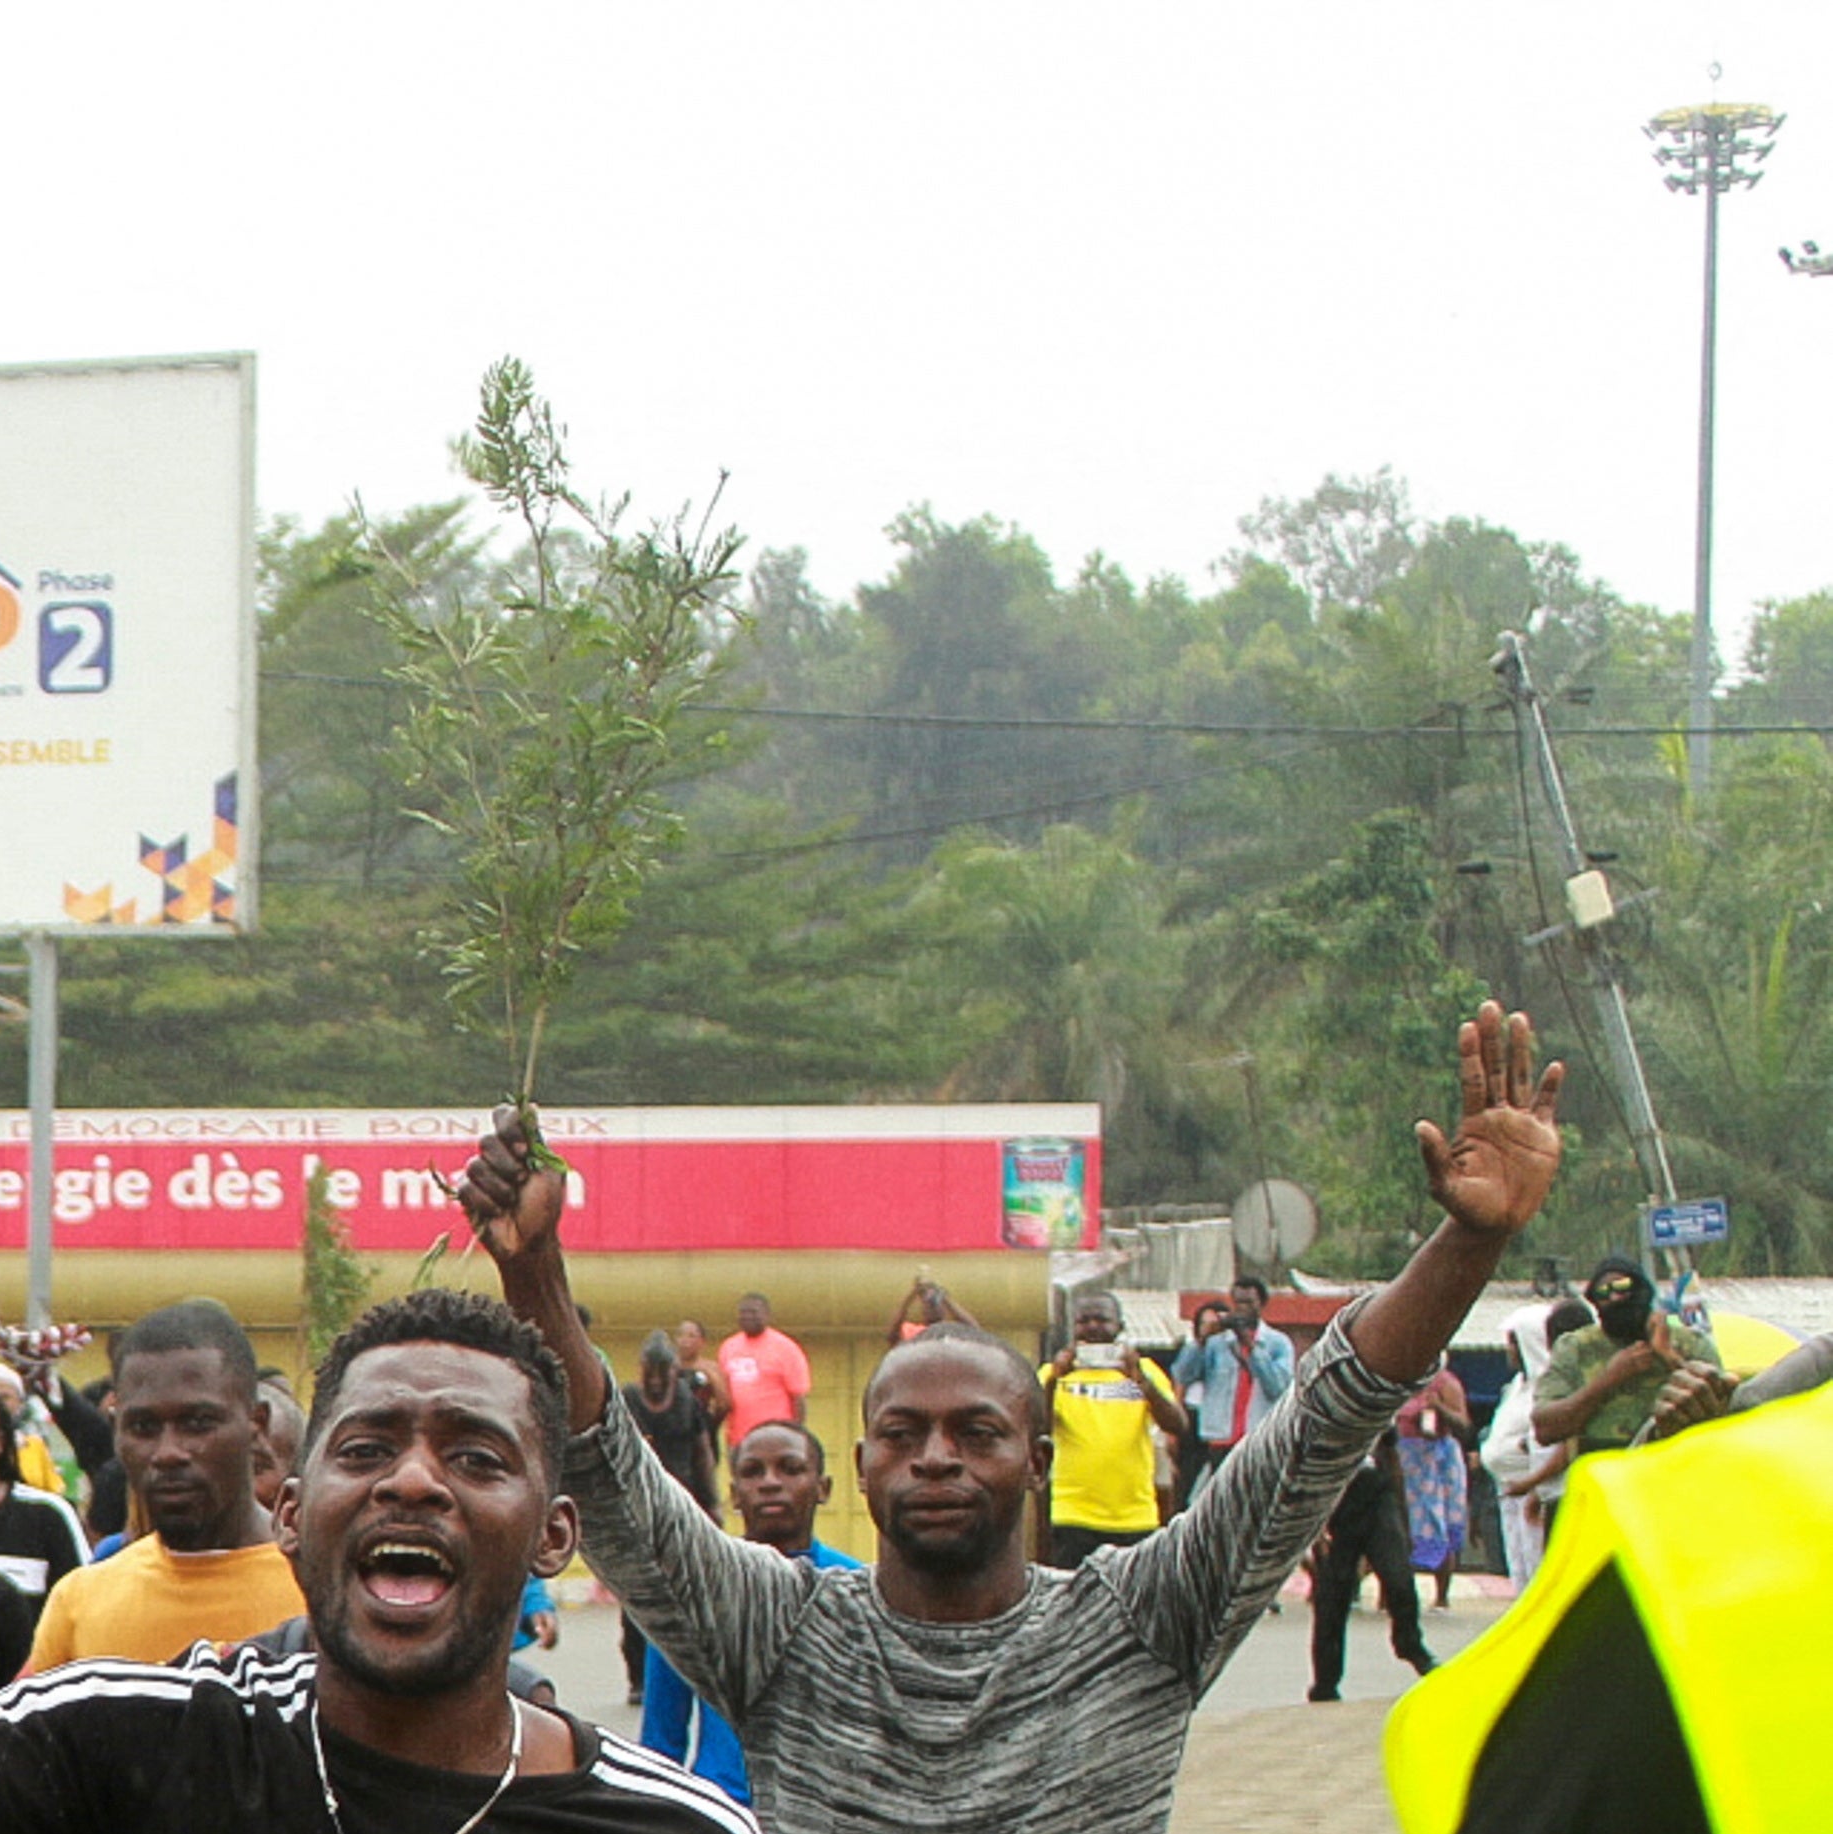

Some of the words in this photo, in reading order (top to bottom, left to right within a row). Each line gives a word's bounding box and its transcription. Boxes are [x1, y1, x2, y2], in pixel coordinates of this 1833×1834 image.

[37, 569, 114, 593] Phase
[47, 605, 106, 690] 2
[368, 1115, 480, 1136] BON
[167, 1151, 284, 1210] dès
